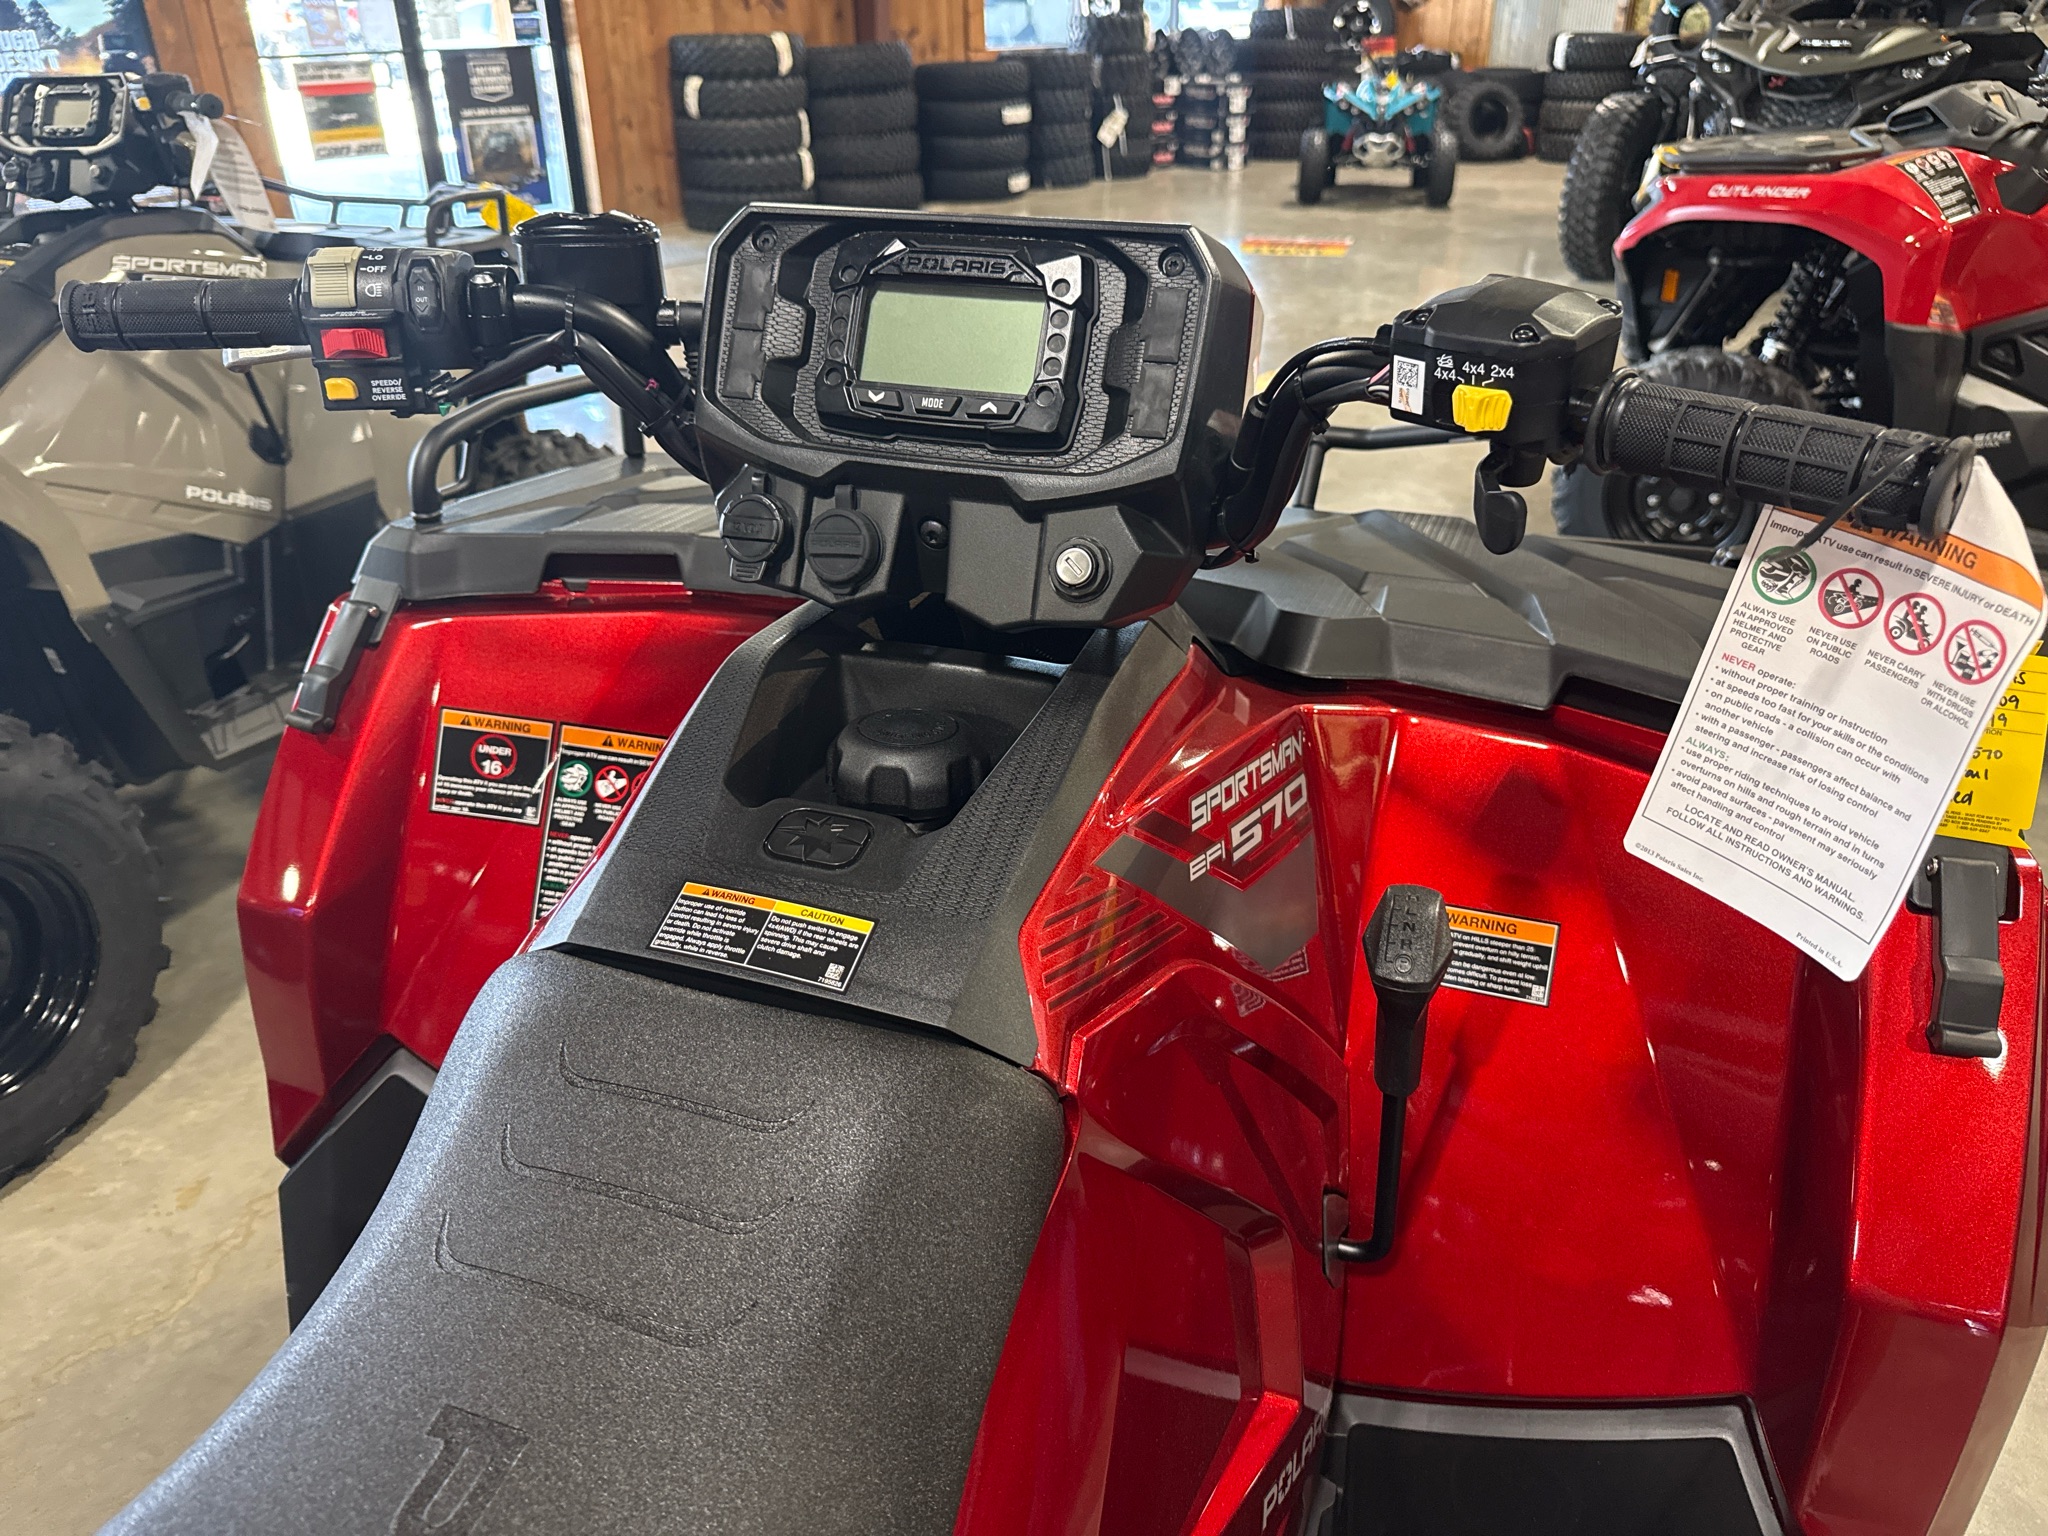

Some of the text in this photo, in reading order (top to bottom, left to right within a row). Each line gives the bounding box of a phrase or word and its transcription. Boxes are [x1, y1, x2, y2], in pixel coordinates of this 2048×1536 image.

[1707, 183, 1812, 199] OUTLANDER
[111, 255, 267, 278] SPORTSMAN
[366, 265, 387, 273] OFF
[907, 256, 1006, 275] POLARIS
[371, 378, 402, 387] SPEEDO/
[1434, 361, 1515, 381] 4x4 4x4 2x4
[921, 397, 944, 409] MODE
[1835, 542, 1855, 554] use
[1854, 549, 1874, 561] can
[1873, 555, 1903, 571] result
[1902, 564, 1913, 575] in
[1912, 568, 1952, 591] SEVERE
[1950, 584, 1985, 605] INJURY
[1983, 601, 1996, 610] or
[1993, 603, 2035, 626] DEATH
[1732, 608, 1794, 635] AN APPROVED
[1740, 601, 1797, 627] ALWAYS USE
[1729, 627, 1783, 652] PROTECTIVE
[1732, 618, 1787, 643] HELMET AND
[1808, 625, 1858, 651] NEVER USE
[1741, 641, 1766, 656] GEAR
[1806, 635, 1852, 659] ON PUBLIC
[1809, 647, 1841, 665] ROADS
[1721, 652, 1797, 689] NEVER operate:
[1863, 658, 1919, 689] PASSENGERS
[1867, 648, 1926, 680] NEVER CARRY
[1721, 667, 1888, 746] without proper training or instruction
[474, 716, 531, 734] WARNING
[478, 744, 512, 756] UNDER
[617, 737, 665, 752] WARNIN
[1684, 736, 1730, 762] ALWAYS:
[481, 759, 503, 776] 16
[1191, 730, 1303, 832] SPORTSMAN
[1685, 748, 1880, 850] use proper riding techniques to avoid vehicle
[1231, 773, 1308, 862] 570
[1670, 781, 1786, 842] affect handling and control
[1189, 840, 1227, 882] EFI
[1654, 851, 1675, 869] Polaris
[1675, 861, 1692, 876] Sales
[1666, 806, 1864, 922] FOLLOW ALL INSTRUCTIONS AND WARNINGS.
[1684, 803, 1855, 903] LOCATE AND READ OWNER'S MANUAL.
[711, 890, 756, 906] WARNING
[800, 908, 845, 926] CAUTION
[1402, 921, 1416, 932] N
[1447, 912, 1517, 935] WARNING
[1400, 938, 1412, 951] R
[1795, 930, 1816, 949] Printed
